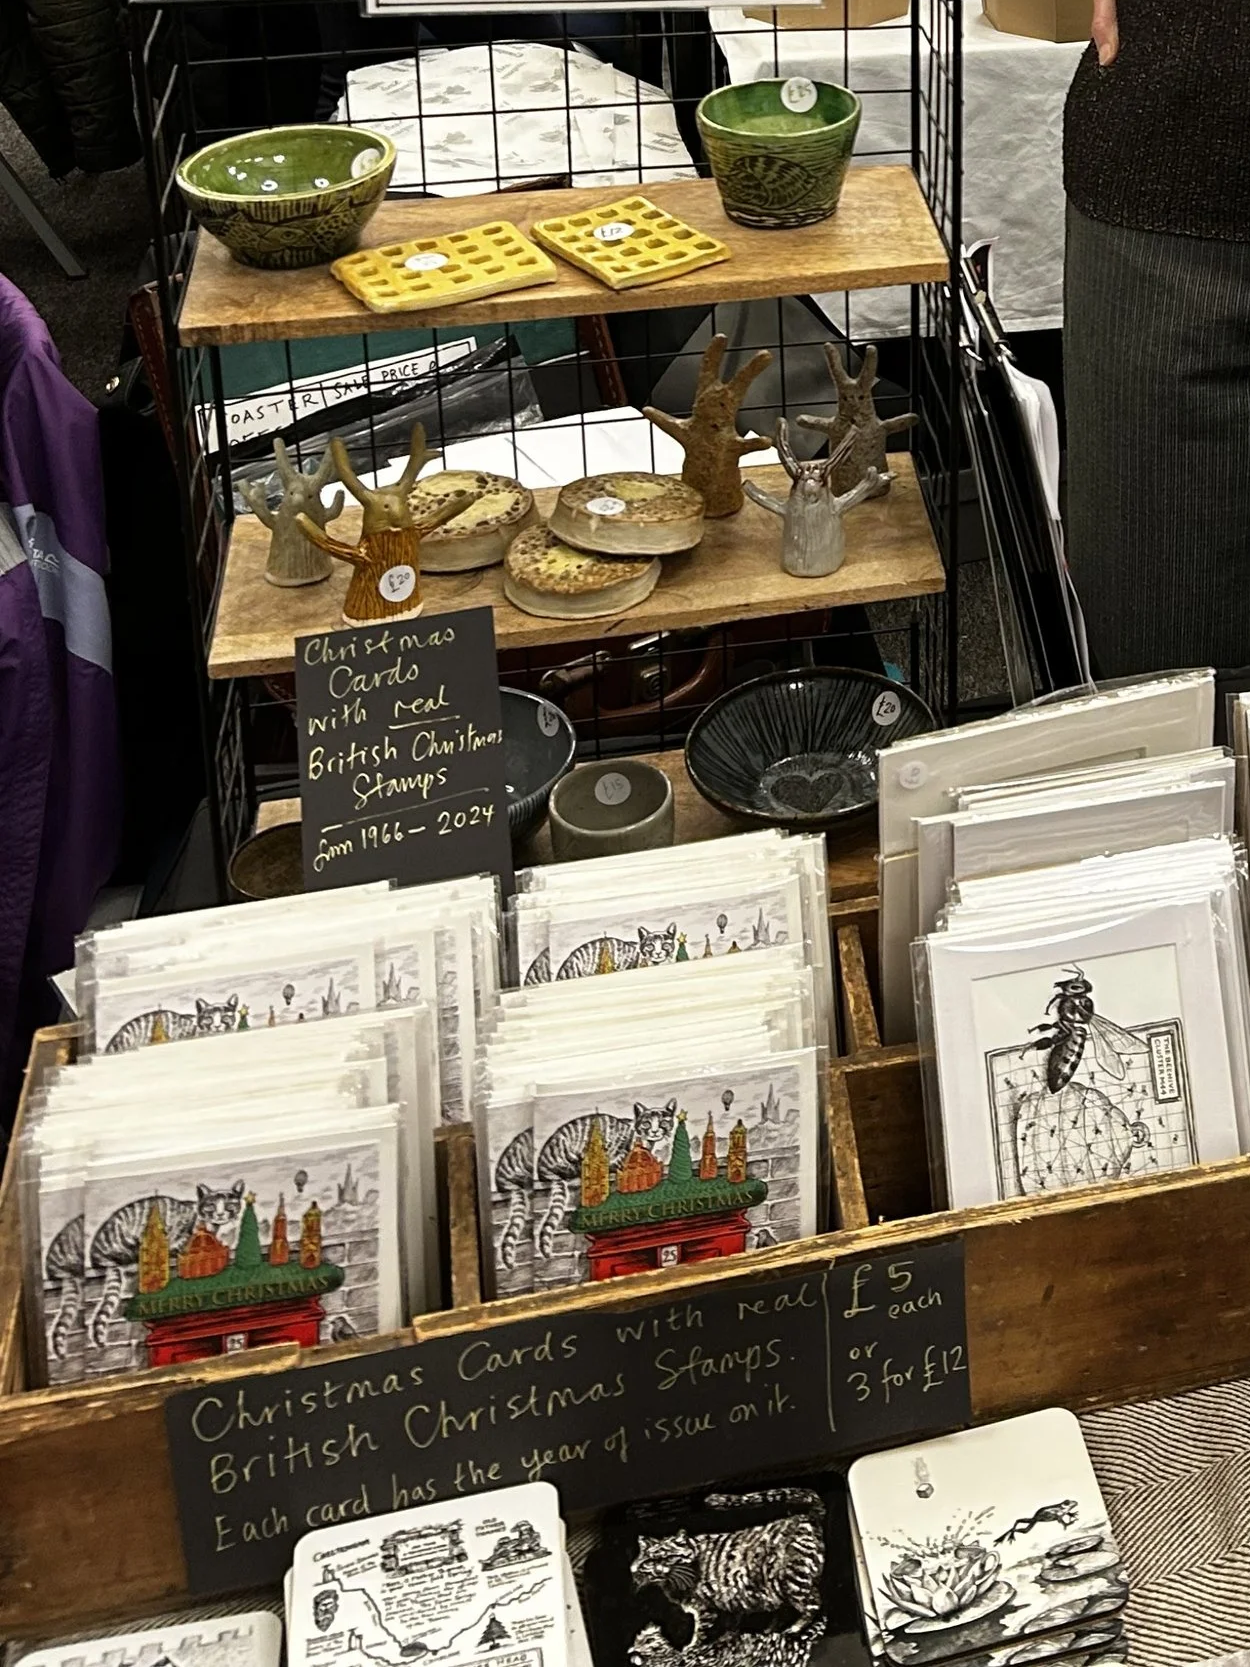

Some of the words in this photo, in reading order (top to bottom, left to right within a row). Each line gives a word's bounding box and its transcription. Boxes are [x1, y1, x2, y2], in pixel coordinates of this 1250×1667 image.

[228, 394, 319, 425] OASTER
[381, 362, 419, 382] PRICE
[388, 572, 411, 594] £20
[304, 627, 455, 666] Christmas
[329, 656, 419, 699] Cards
[308, 697, 368, 736] with
[394, 685, 449, 718] real
[876, 695, 897, 718] £20
[308, 736, 398, 780] British
[412, 723, 503, 762] Christmas
[353, 767, 448, 811] Stamps
[361, 821, 405, 850] 1966
[437, 804, 495, 836] 2024
[580, 1208, 645, 1228] MERRY
[646, 1191, 753, 1219] CHRISTMAS
[663, 1250, 678, 1264] 25
[212, 1273, 330, 1307] CHRISTMAS
[887, 1287, 944, 1320] each
[191, 1364, 425, 1443] Christmas
[457, 1331, 577, 1382] Cards
[616, 1304, 704, 1344] with
[736, 1282, 818, 1320] real
[848, 1341, 880, 1361] or
[847, 1371, 871, 1402] 3
[881, 1358, 916, 1404] for
[923, 1344, 968, 1392] £12
[210, 1423, 379, 1495] British
[404, 1373, 625, 1450] Christmas
[214, 1507, 290, 1553] Each
[305, 1484, 372, 1528] card
[391, 1472, 438, 1512] has
[453, 1459, 503, 1492] the
[520, 1438, 593, 1482] year
[603, 1426, 629, 1464] of
[644, 1412, 717, 1443] issue
[729, 1402, 760, 1424] on
